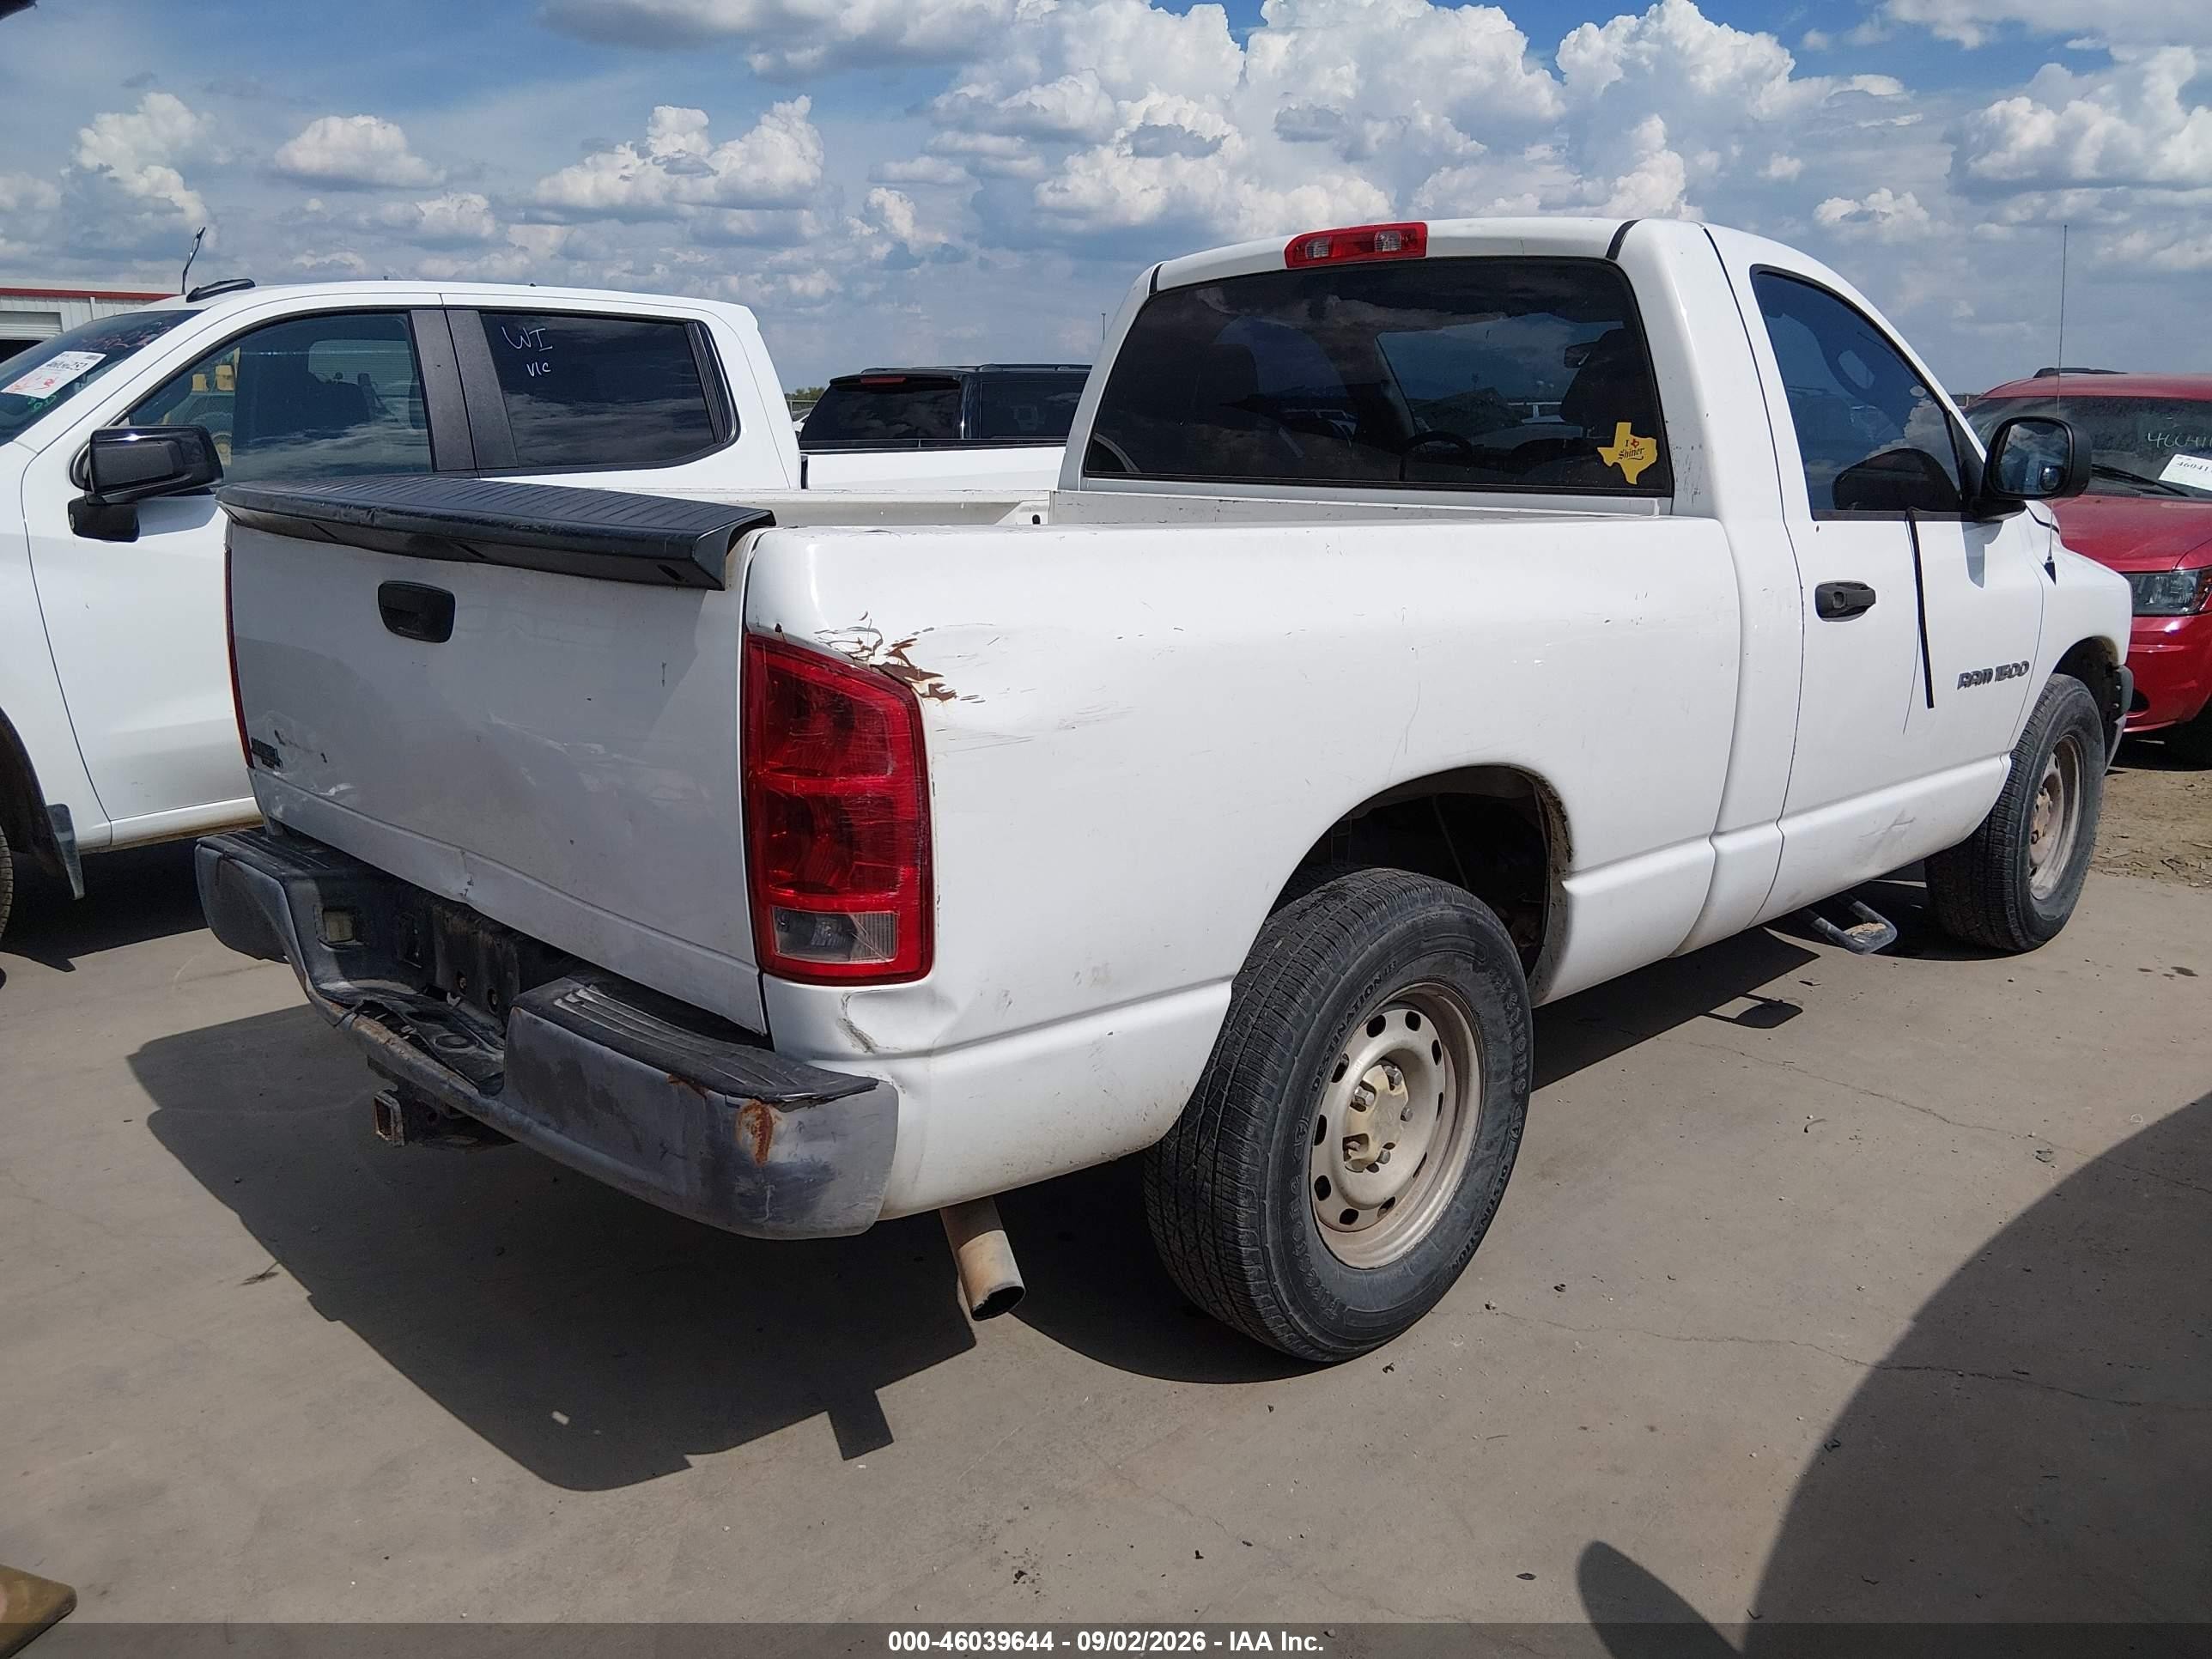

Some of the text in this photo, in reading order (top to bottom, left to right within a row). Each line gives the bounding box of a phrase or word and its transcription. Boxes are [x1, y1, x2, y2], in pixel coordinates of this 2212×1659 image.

[501, 326, 553, 352] WI
[1618, 447, 1645, 461] Shiner
[2175, 460, 2212, 472] 46041
[1957, 659, 2030, 690] RAM 1500
[1310, 974, 1382, 1093] DESTINATION
